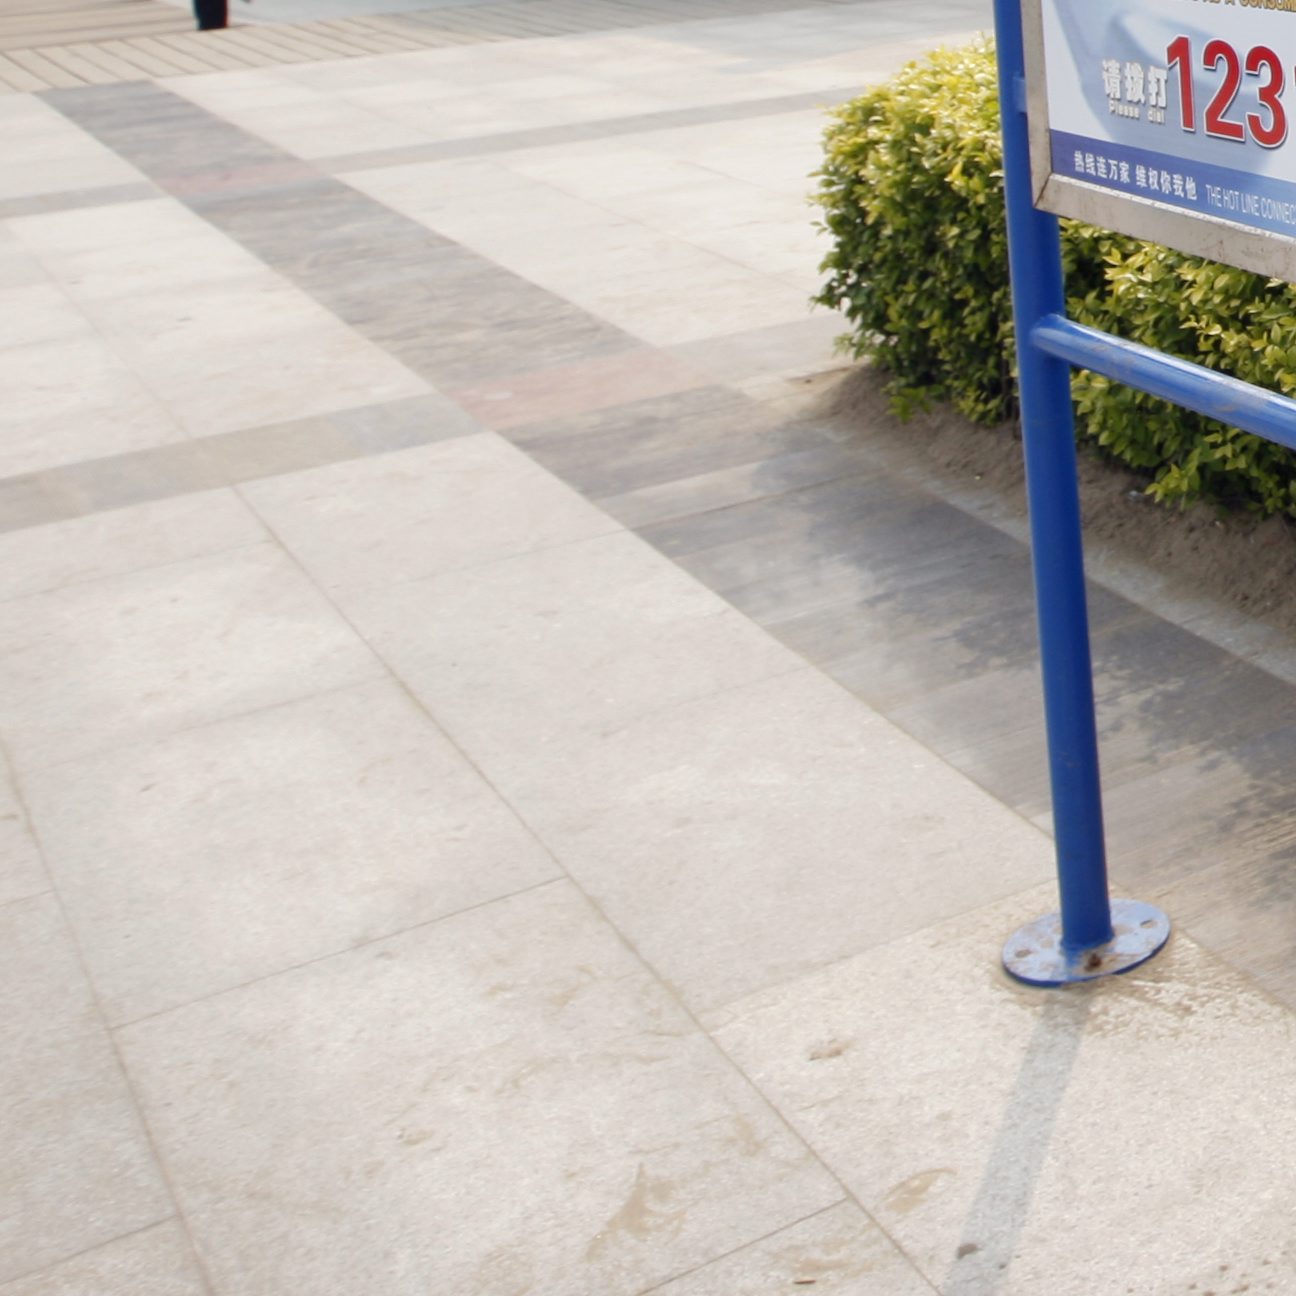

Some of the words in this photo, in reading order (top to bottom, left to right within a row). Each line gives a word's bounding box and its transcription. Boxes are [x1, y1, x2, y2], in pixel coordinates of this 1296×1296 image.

[1102, 59, 1168, 109] 请拨打
[1074, 150, 1131, 183] 热线连万家
[1135, 164, 1198, 201] 维权你我他
[1205, 184, 1223, 208] THE
[1223, 189, 1241, 212] HOT
[1241, 193, 1260, 217] LINE
